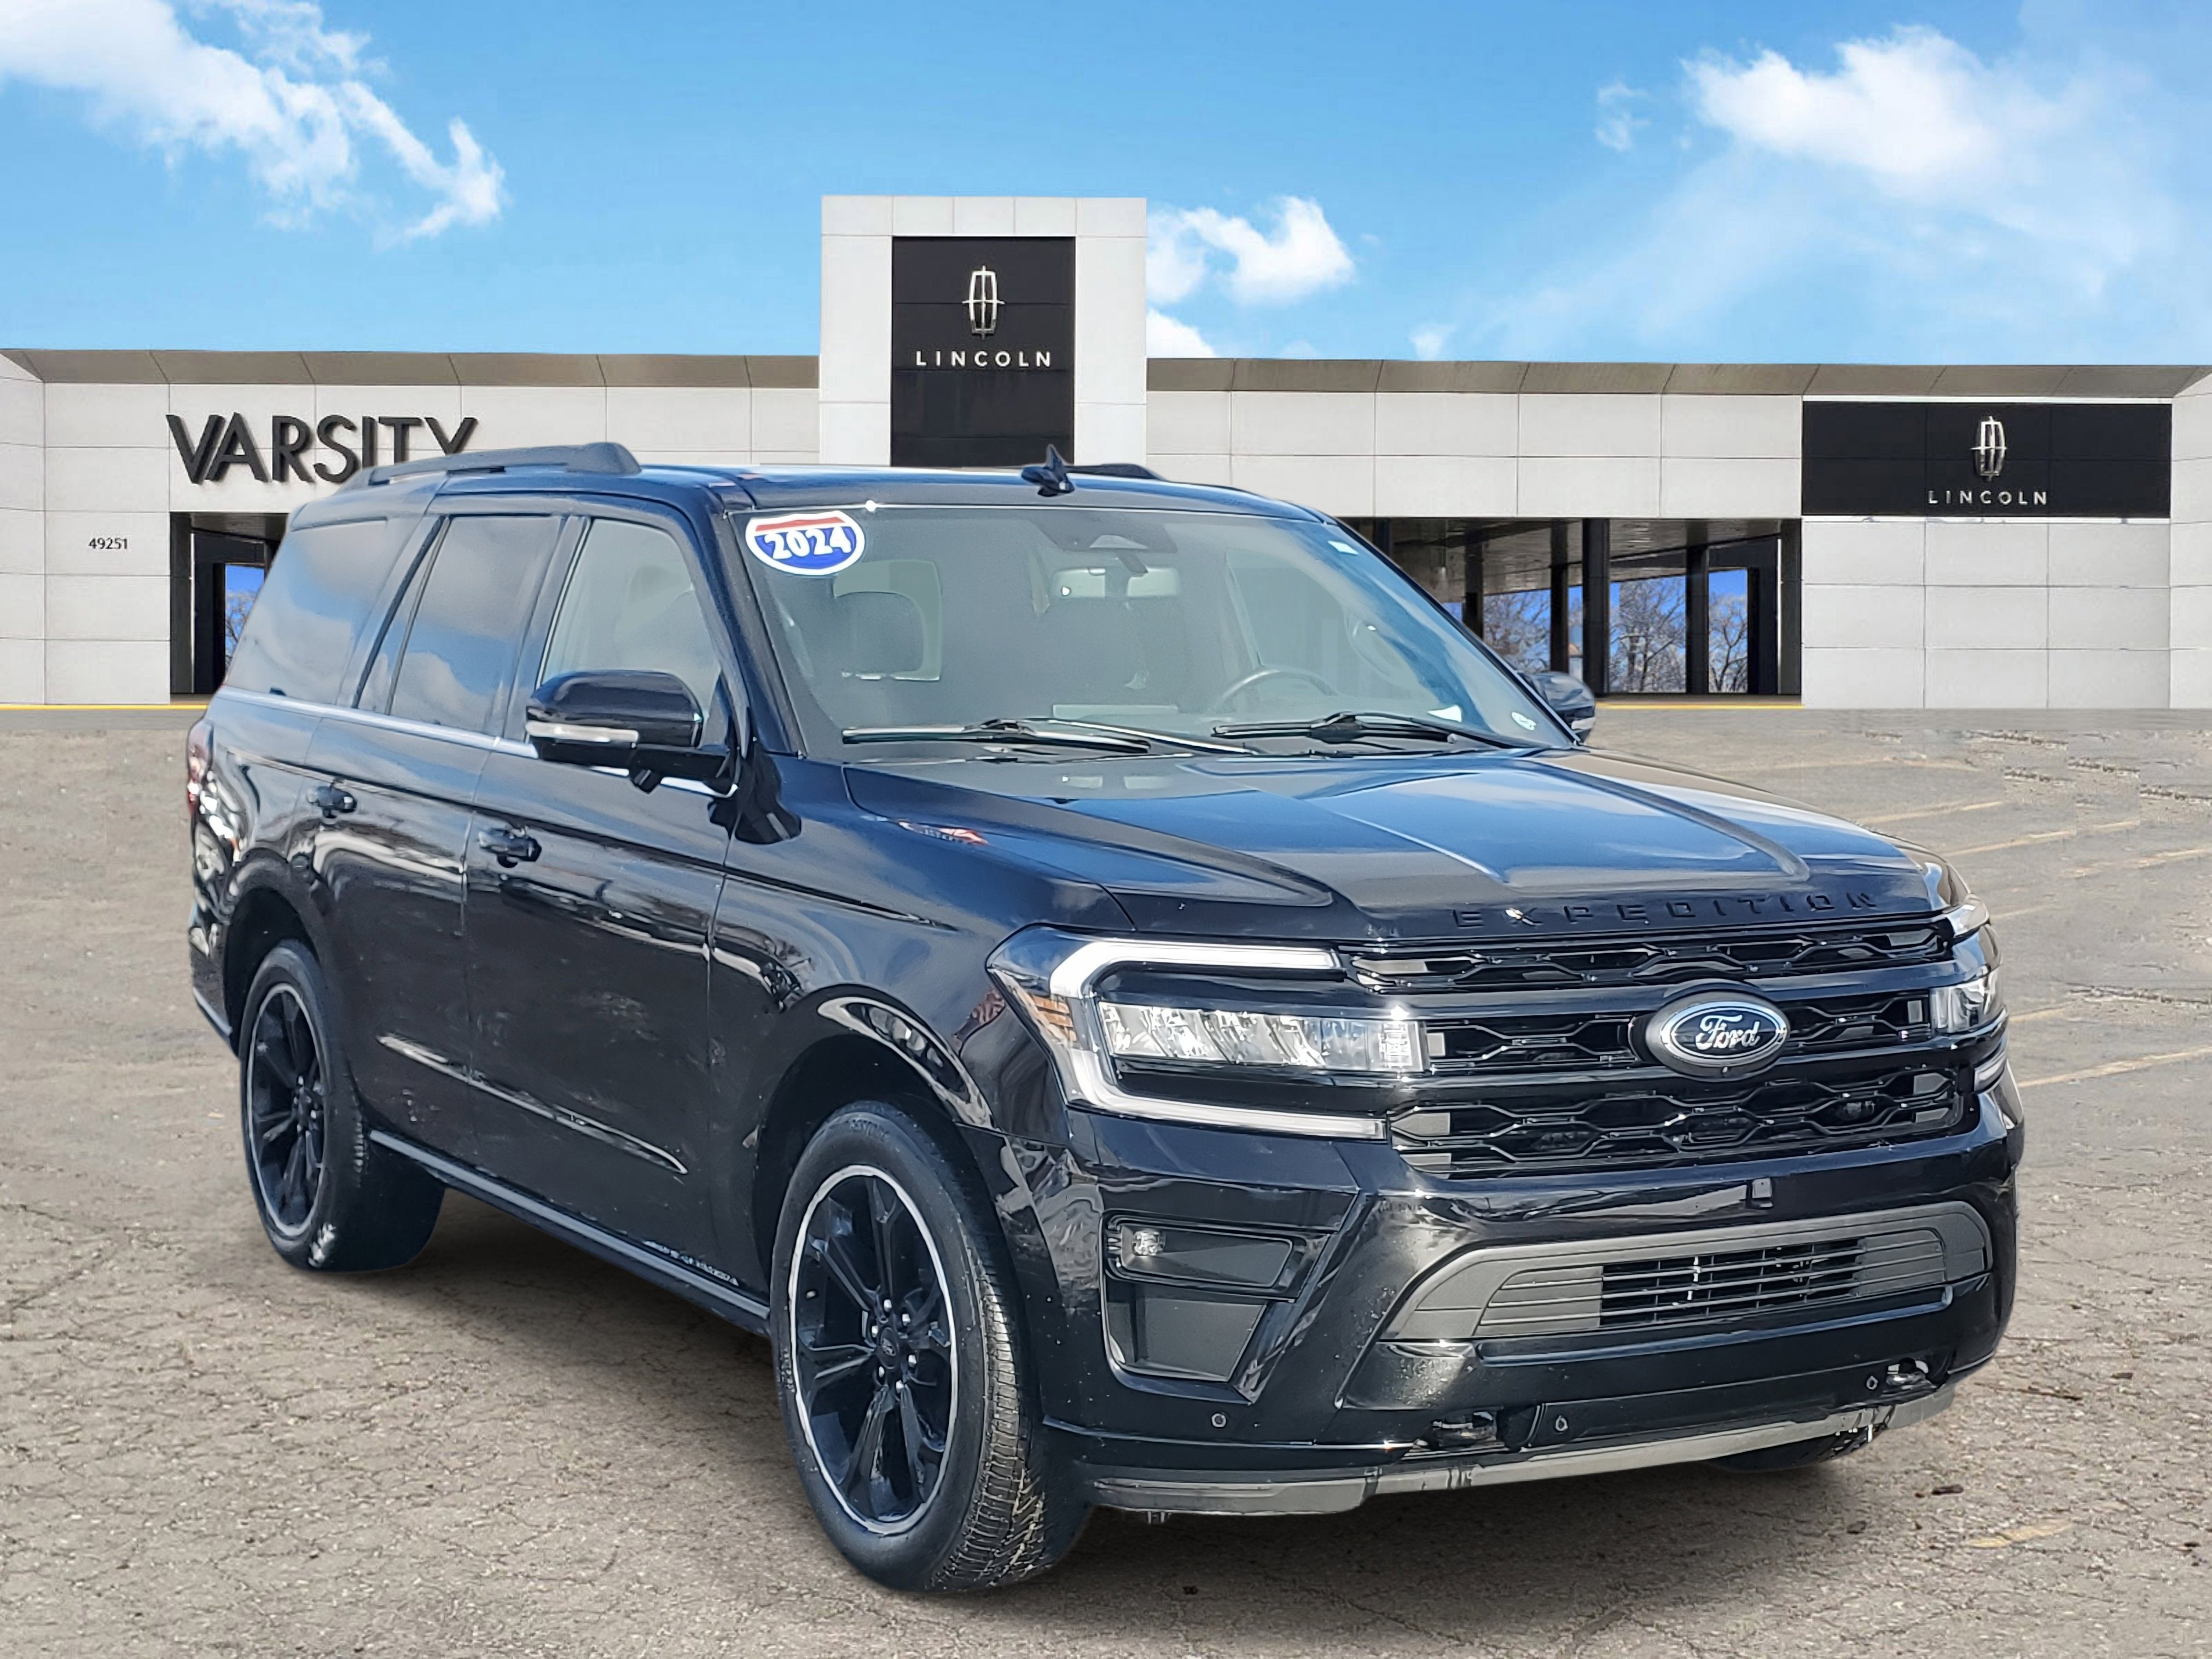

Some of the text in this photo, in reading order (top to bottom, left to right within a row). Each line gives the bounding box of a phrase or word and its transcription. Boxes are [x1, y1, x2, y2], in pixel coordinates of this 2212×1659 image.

[915, 350, 1050, 367] LINCOLN
[165, 411, 478, 484] VARSITY
[1927, 490, 2047, 505] LINCOLN
[88, 537, 127, 549] 49251
[764, 526, 852, 559] 2024
[1452, 892, 1878, 927] EXPEDITION
[1696, 1014, 1761, 1051] Ford
